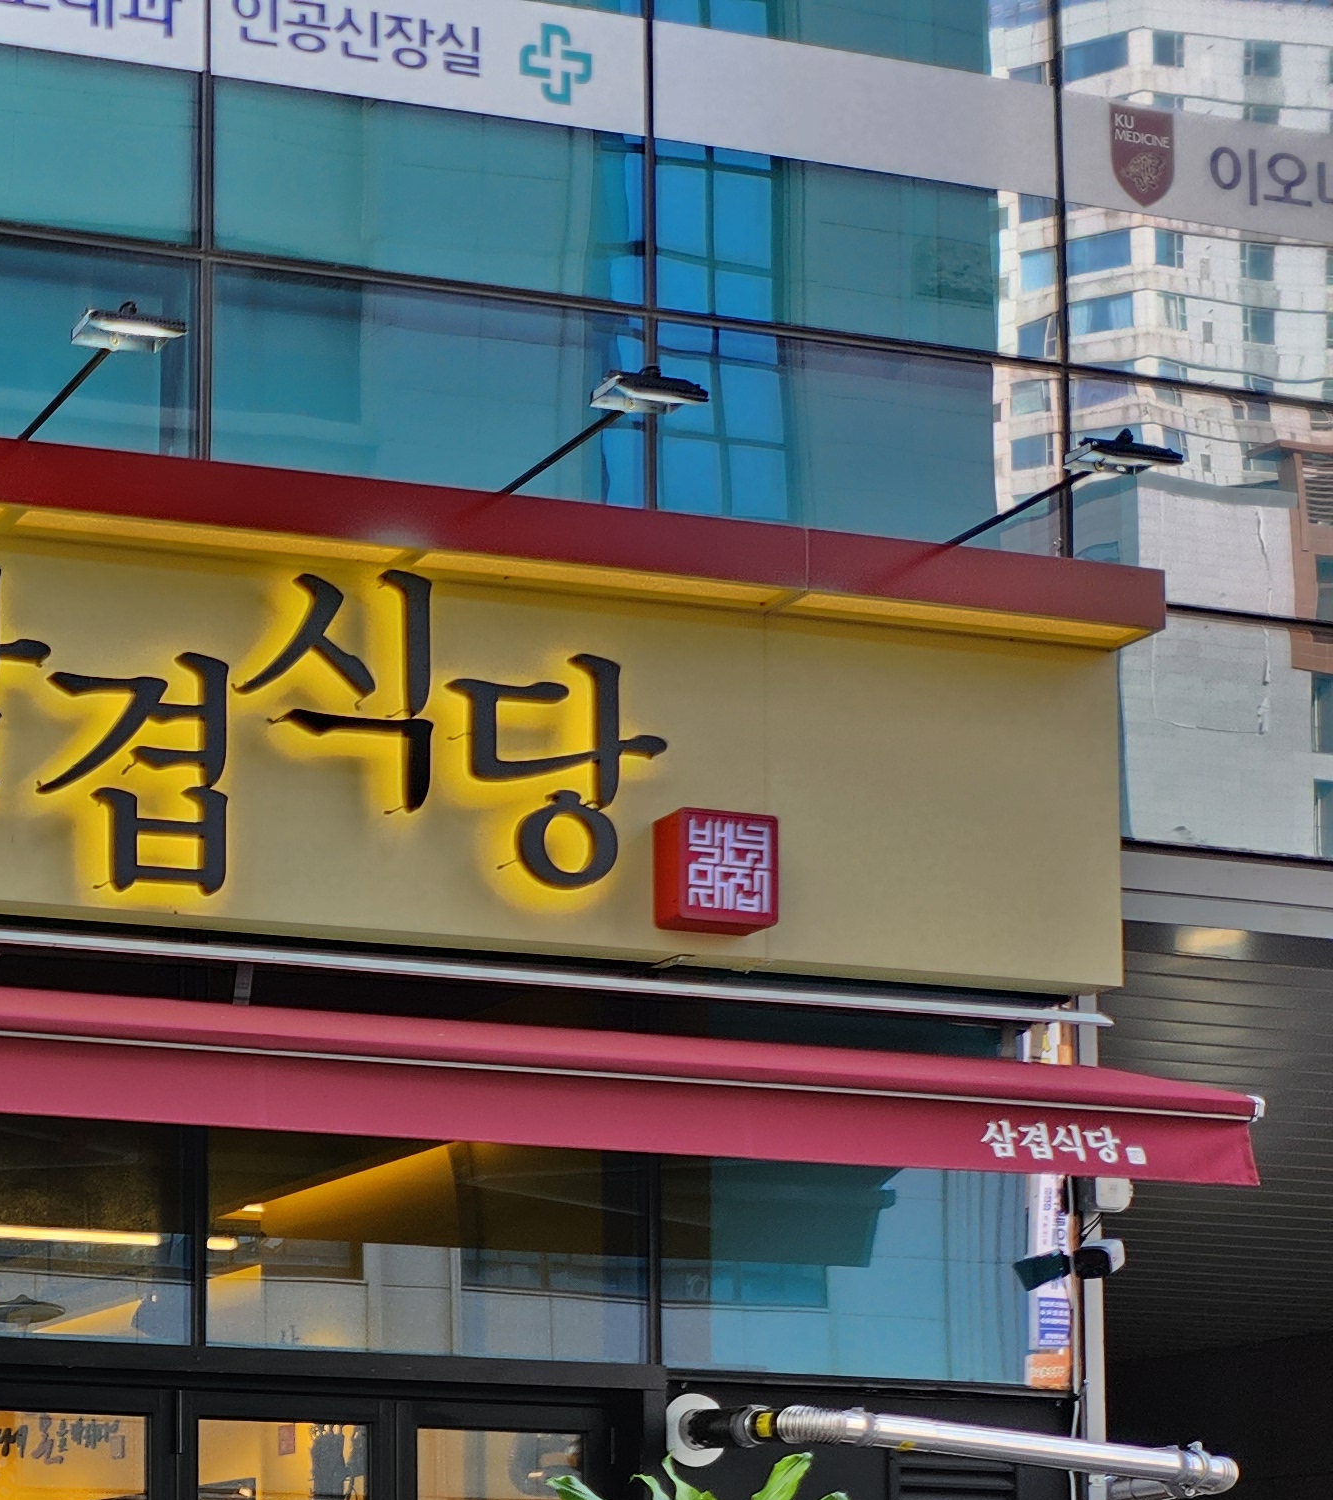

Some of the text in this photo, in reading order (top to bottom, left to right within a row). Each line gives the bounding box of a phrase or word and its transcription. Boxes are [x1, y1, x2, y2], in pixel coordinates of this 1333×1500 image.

[234, 0, 483, 78] 인공신장실
[1114, 113, 1134, 129] KU
[1114, 129, 1170, 149] MEDICINE
[981, 1119, 1121, 1164] 삼겹식당
